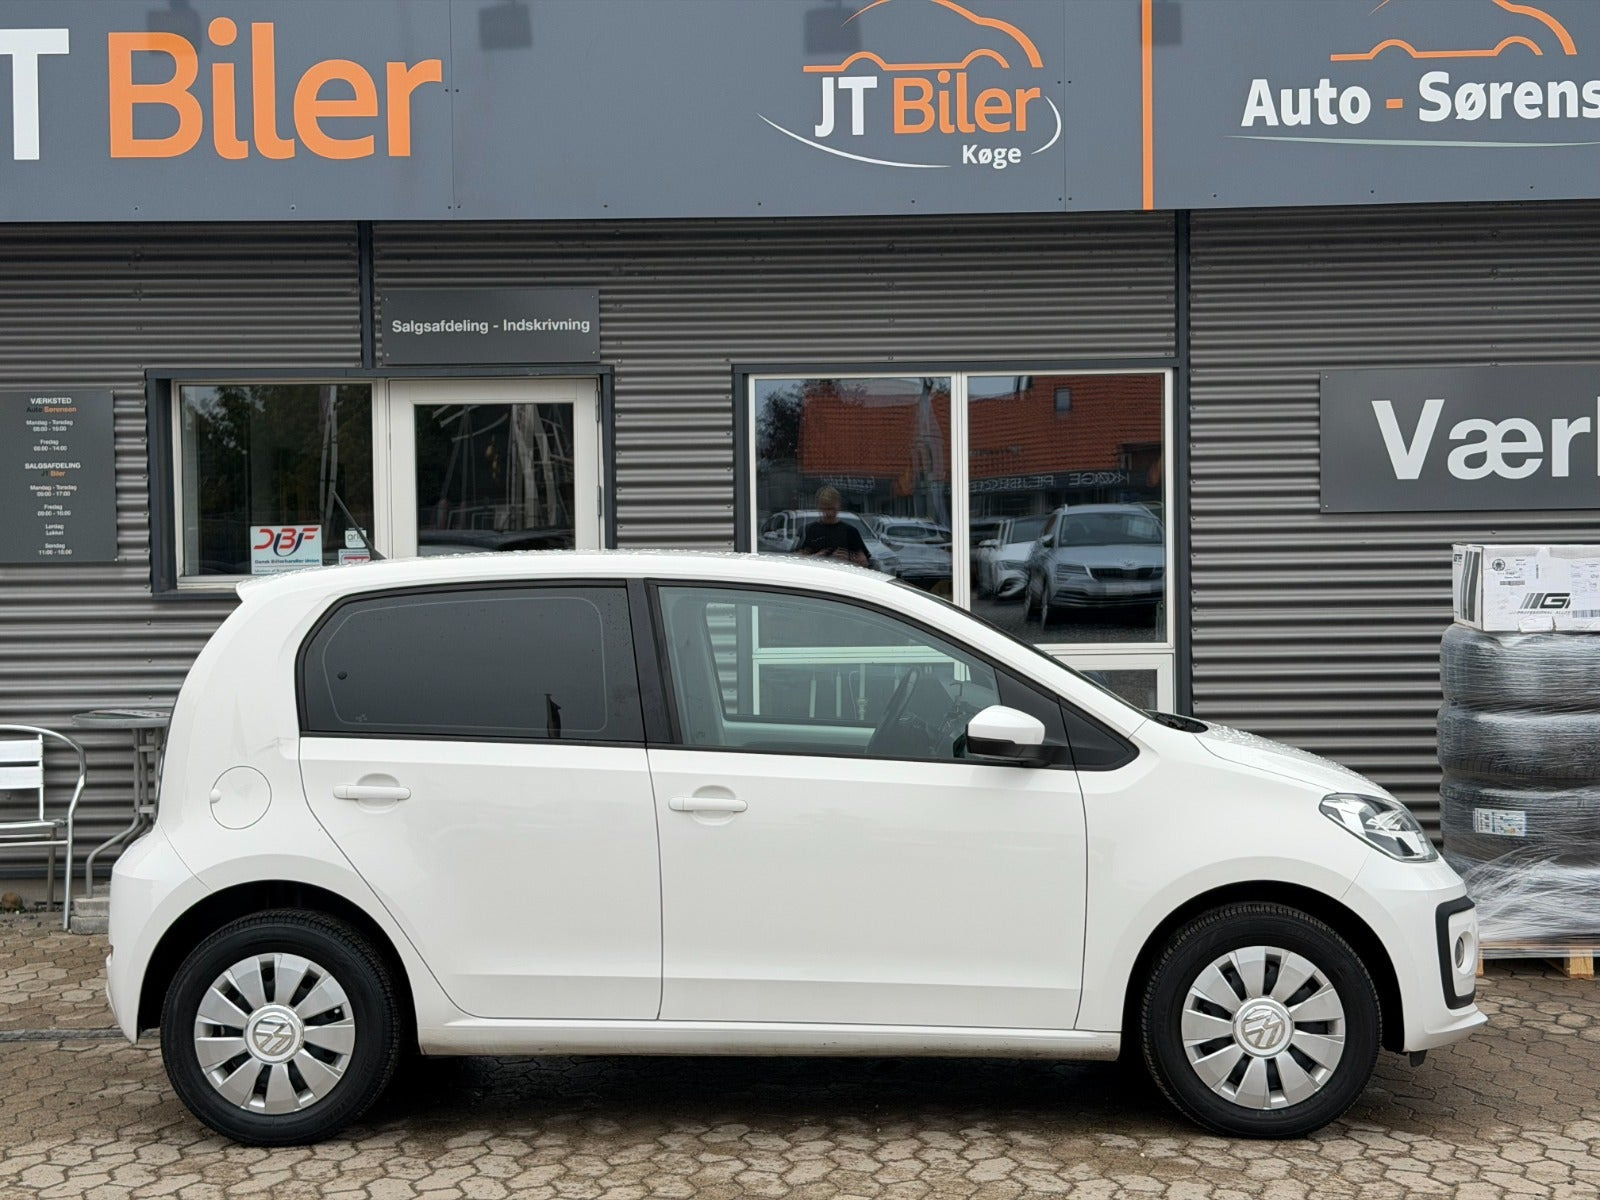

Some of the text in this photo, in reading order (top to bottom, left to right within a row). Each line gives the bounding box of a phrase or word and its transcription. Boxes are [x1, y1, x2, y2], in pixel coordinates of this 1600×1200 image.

[107, 16, 443, 160] Biler
[814, 70, 1041, 138] JT Biler
[1240, 78, 1372, 127] Auto
[962, 144, 1022, 169] Køge
[391, 319, 489, 335] Salgsafdeling
[503, 318, 591, 333] Indskrivning
[1371, 398, 1600, 481] Vær
[25, 462, 81, 470] SALGSAFDELING
